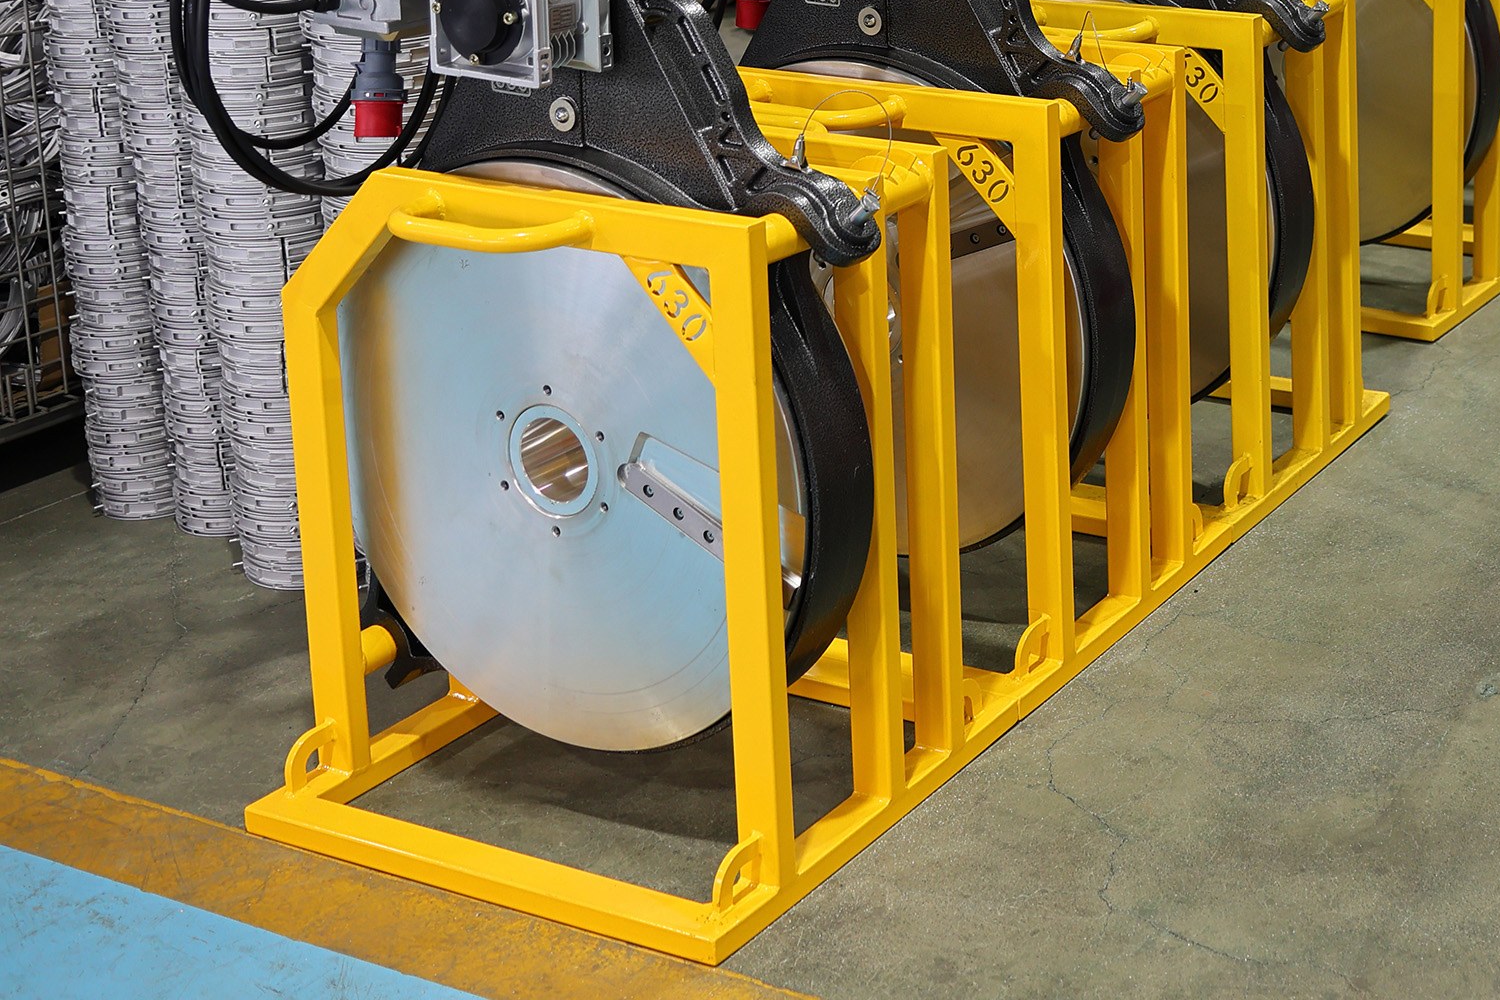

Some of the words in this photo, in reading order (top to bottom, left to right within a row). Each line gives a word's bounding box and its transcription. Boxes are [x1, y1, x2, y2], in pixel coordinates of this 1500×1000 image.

[1184, 53, 1219, 103] 30
[957, 144, 1009, 203] 630
[646, 270, 707, 342] 630
